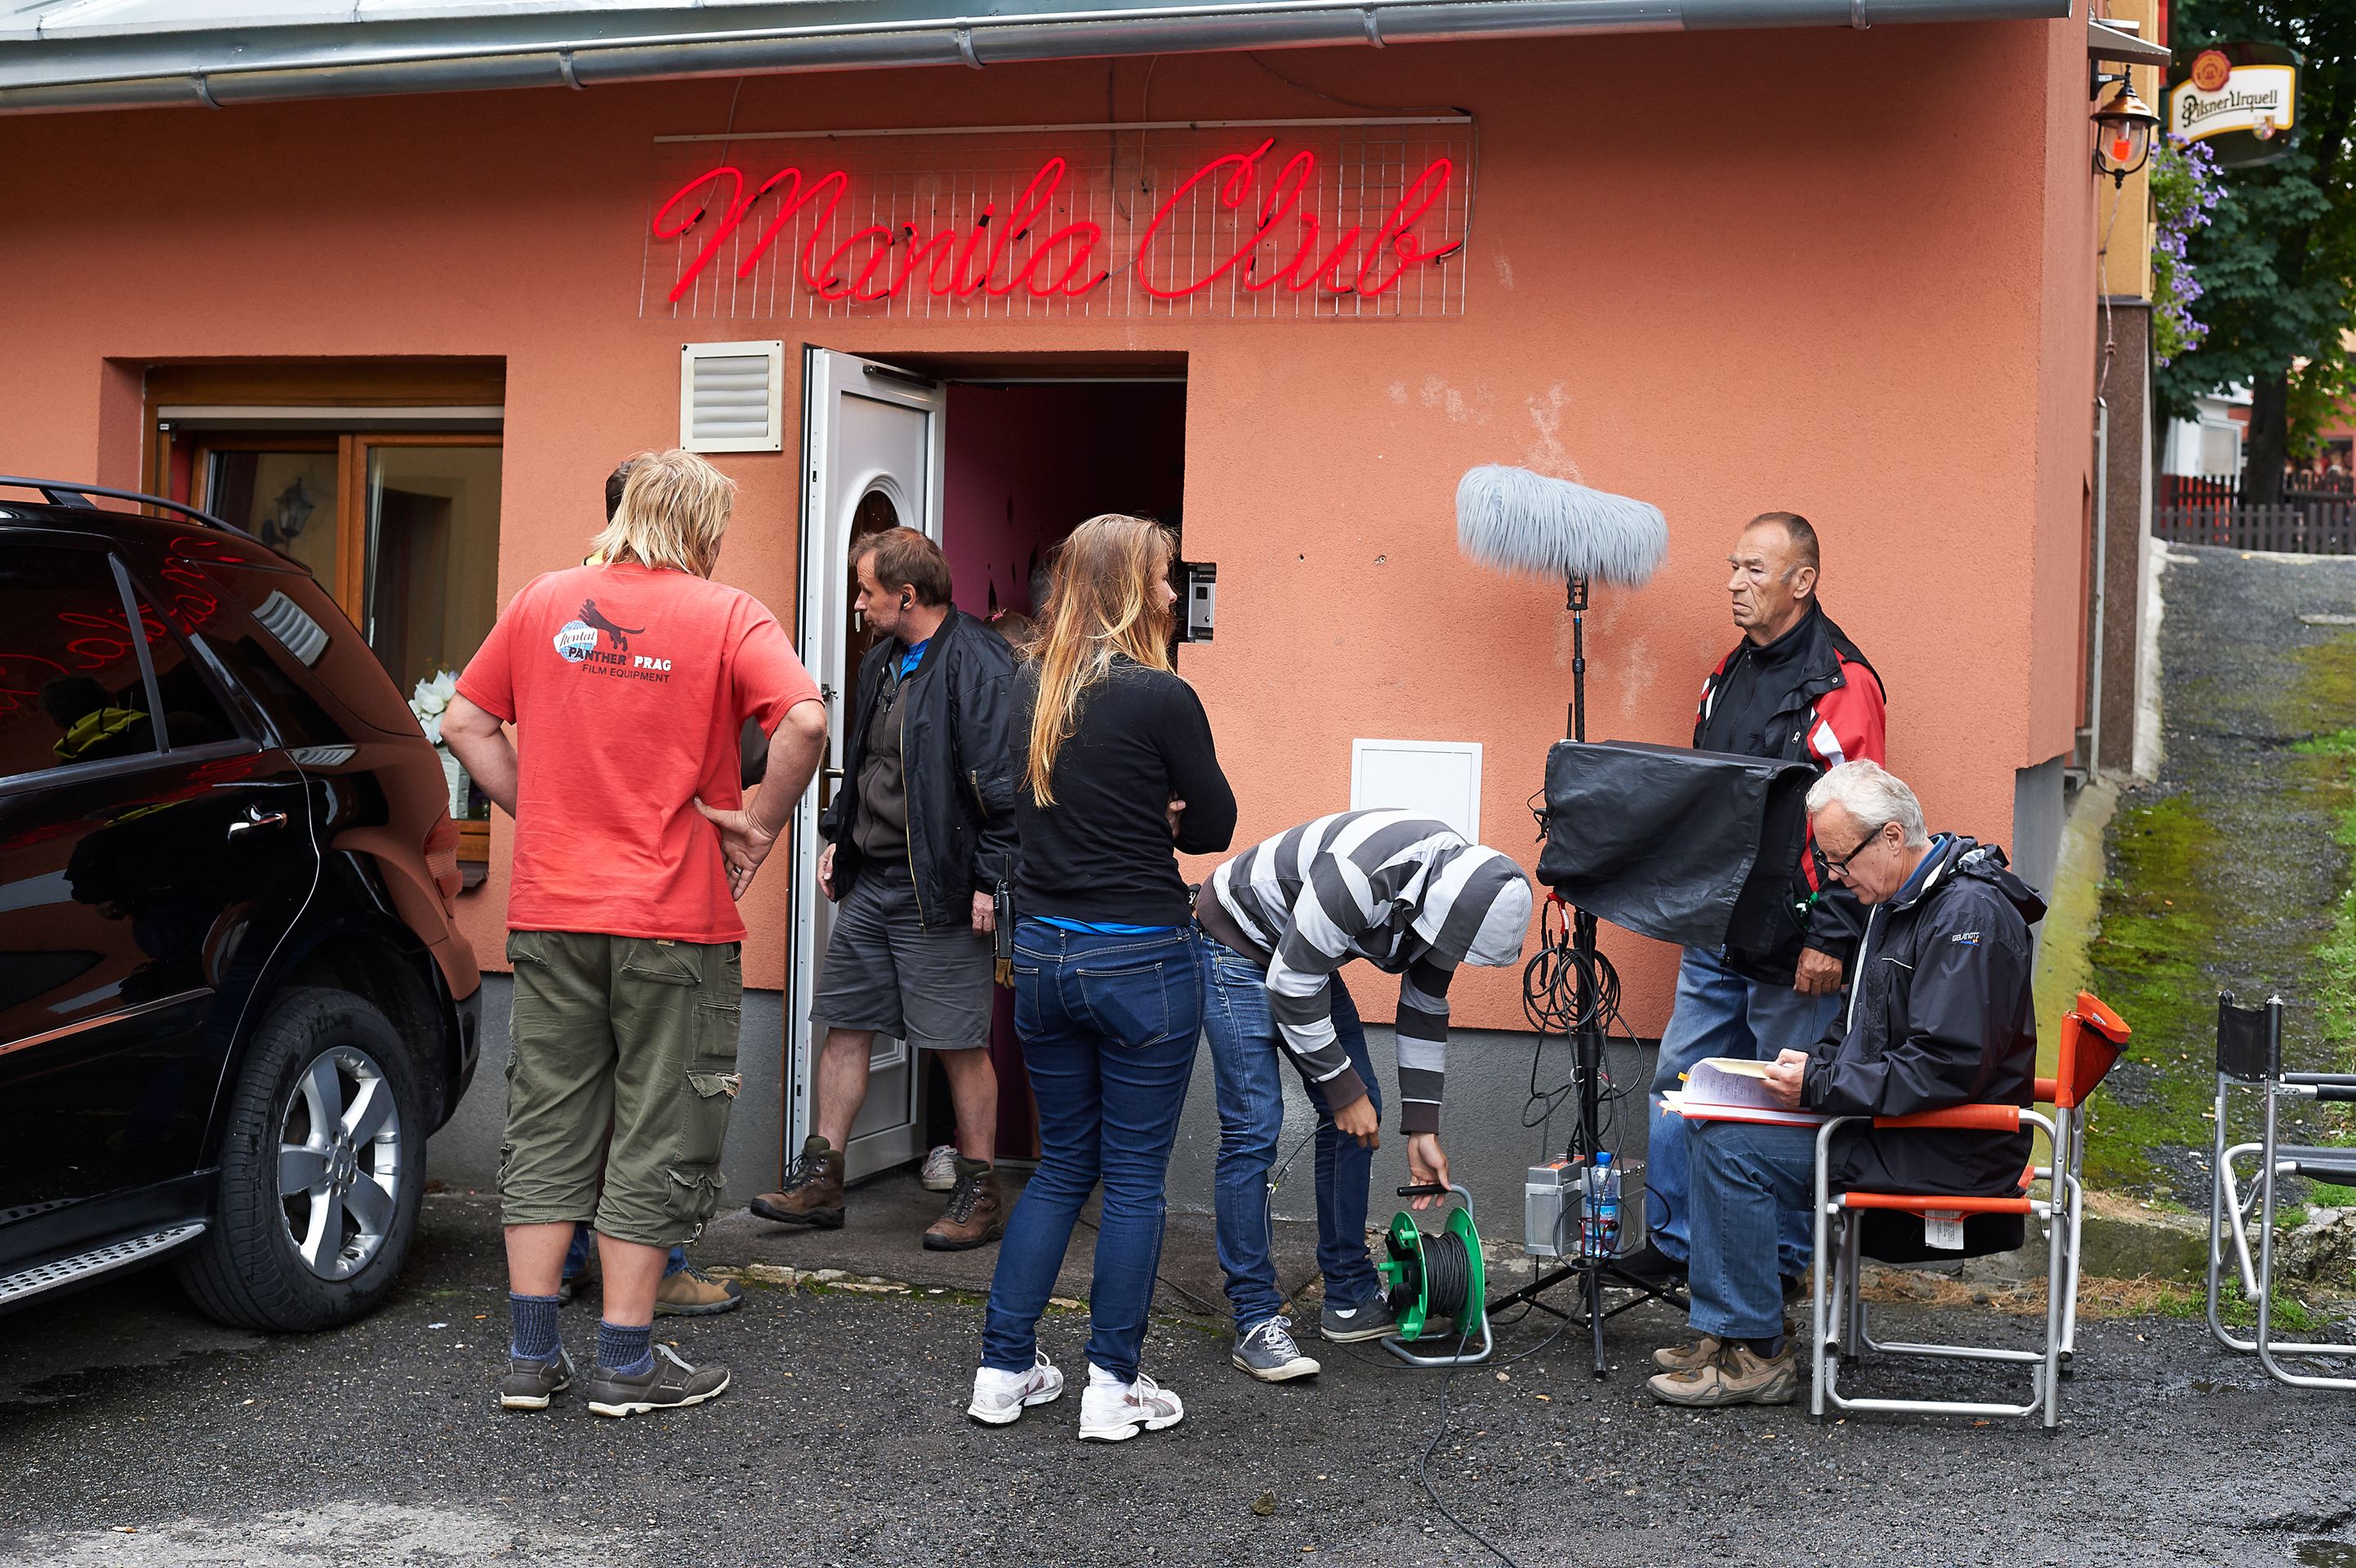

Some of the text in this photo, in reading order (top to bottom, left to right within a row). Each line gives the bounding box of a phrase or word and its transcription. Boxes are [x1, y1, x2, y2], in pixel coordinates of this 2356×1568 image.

[2181, 90, 2278, 128] Pilsner Urquell
[652, 138, 1462, 302] Manila Club
[559, 630, 596, 648] Rental
[568, 646, 672, 671] PANTHER PRAG
[581, 663, 670, 684] FILM EQUIPMENT
